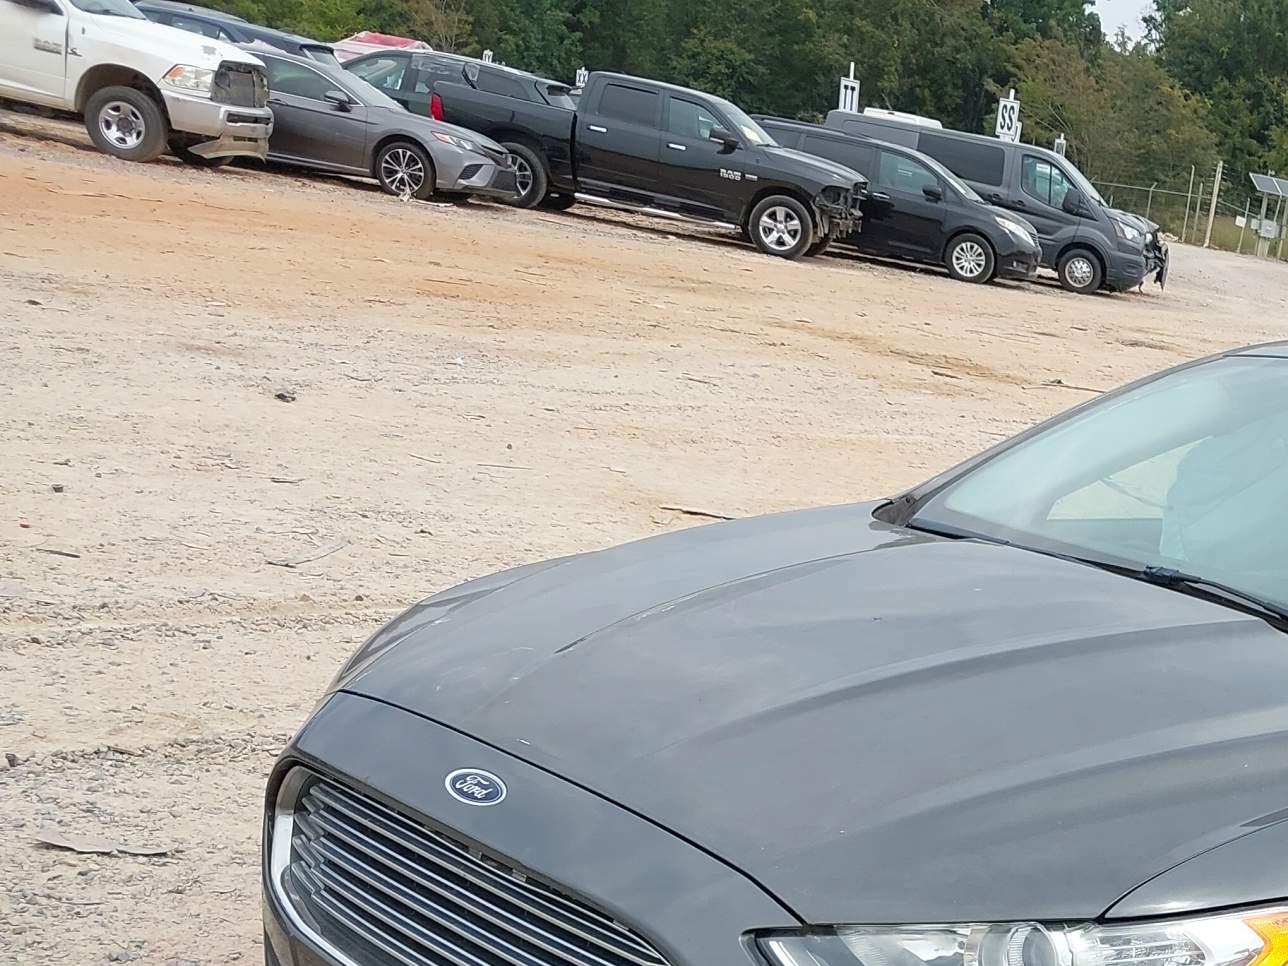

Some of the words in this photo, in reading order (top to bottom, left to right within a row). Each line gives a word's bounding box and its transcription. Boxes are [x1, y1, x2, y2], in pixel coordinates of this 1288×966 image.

[843, 84, 856, 111] TT
[1000, 104, 1015, 131] SS
[455, 775, 493, 799] Ford
